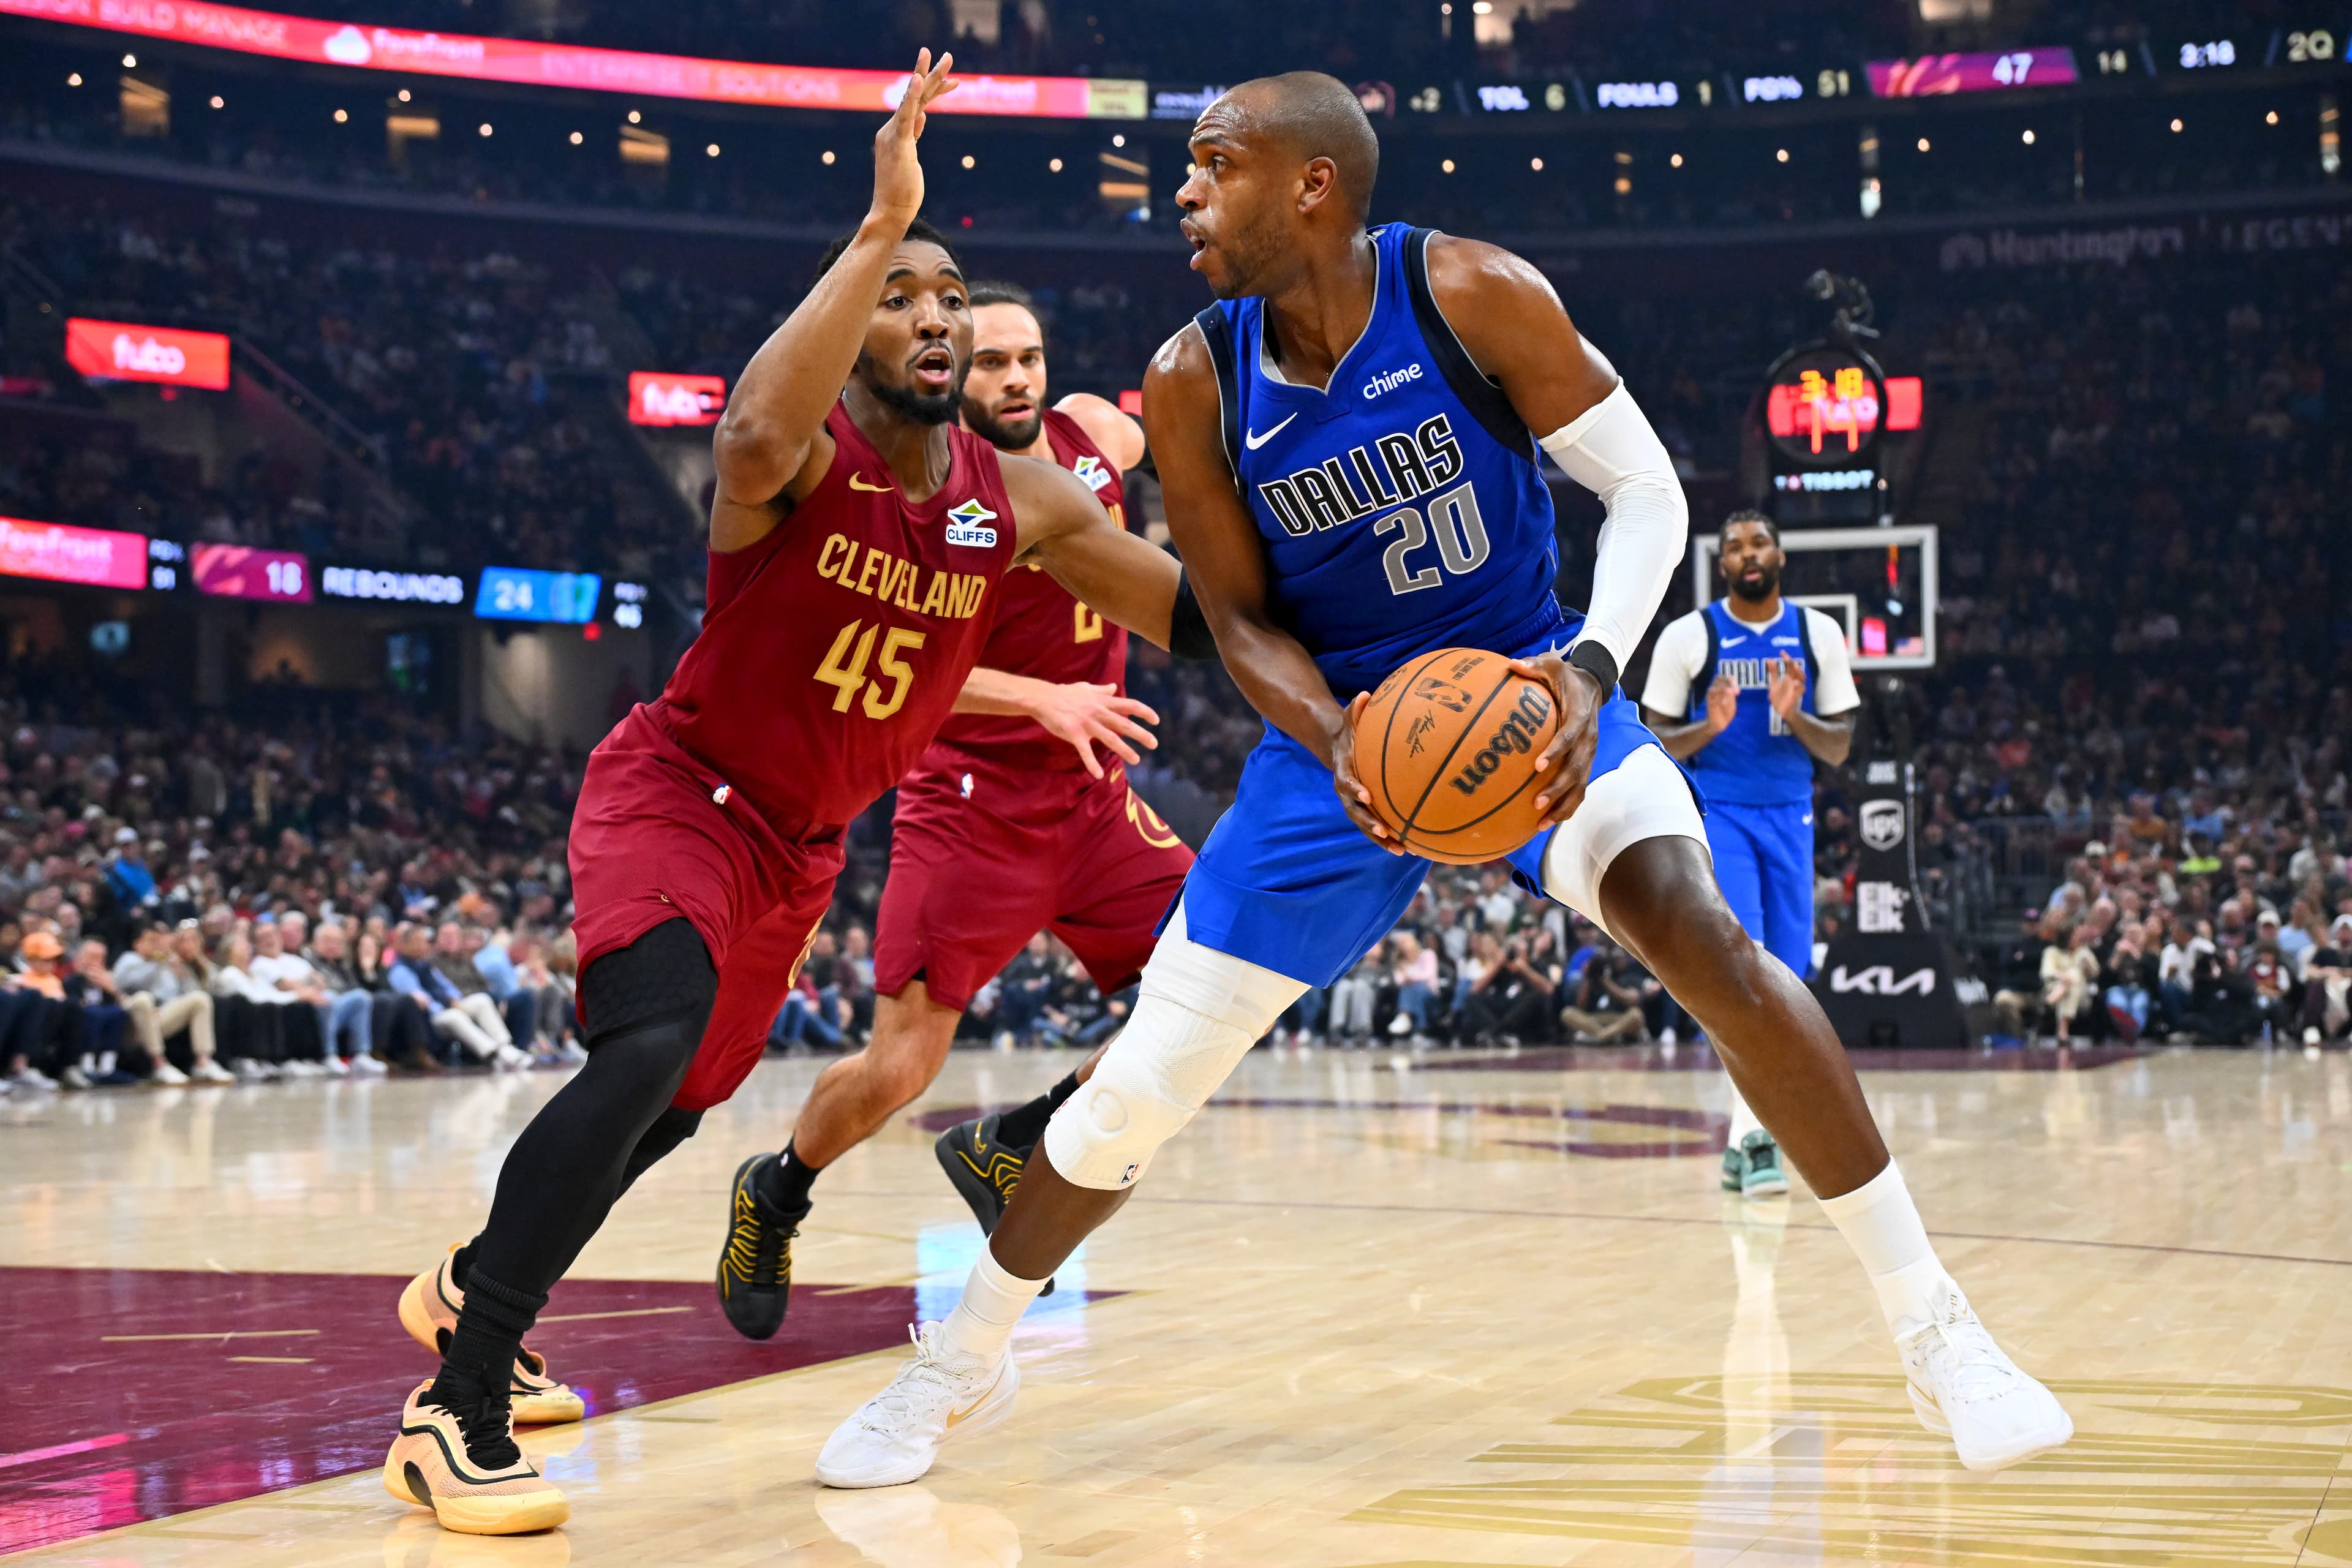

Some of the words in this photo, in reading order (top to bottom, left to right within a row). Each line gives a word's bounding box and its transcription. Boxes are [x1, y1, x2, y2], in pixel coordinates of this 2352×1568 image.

[99, 2, 176, 31] BUILD
[1597, 81, 1678, 108] FOULS
[1992, 52, 2034, 85] 47
[1363, 363, 1423, 399] chime
[1257, 413, 1464, 537] DALLAS
[947, 529, 995, 543] CLIFFS
[1373, 481, 1490, 595] 20
[323, 566, 464, 604] REBOUNDS
[495, 579, 533, 611] 24
[816, 533, 987, 619] CLEVELAND
[813, 619, 927, 720] 45
[1448, 685, 1551, 796] Wilson
